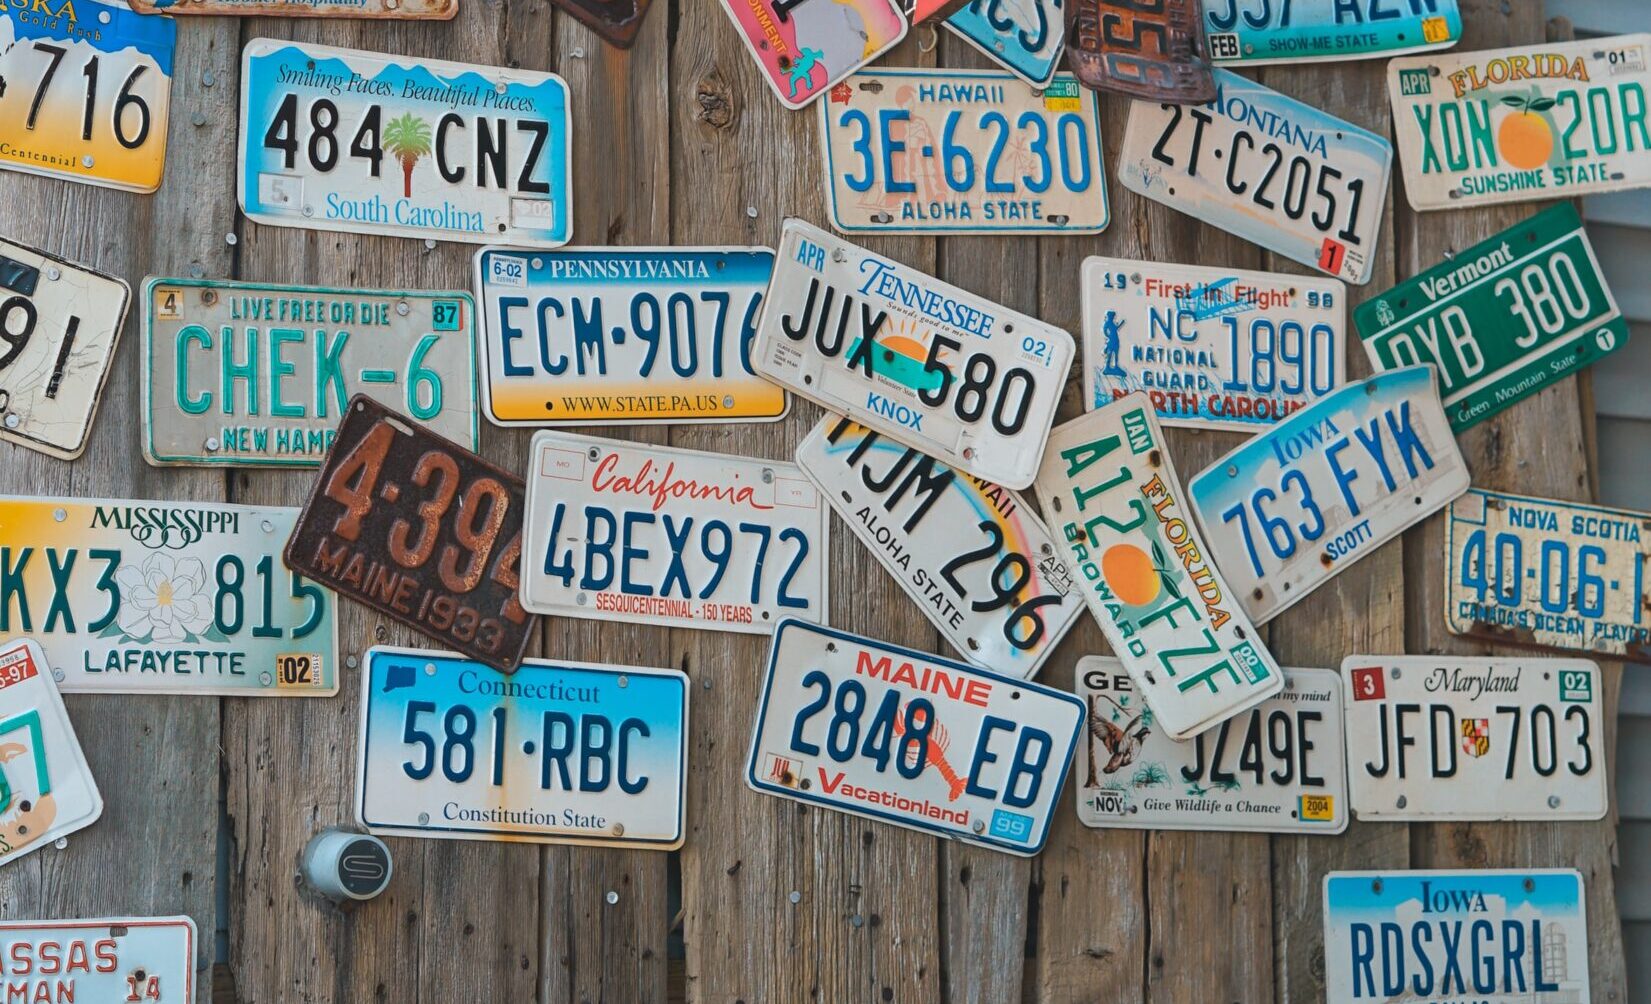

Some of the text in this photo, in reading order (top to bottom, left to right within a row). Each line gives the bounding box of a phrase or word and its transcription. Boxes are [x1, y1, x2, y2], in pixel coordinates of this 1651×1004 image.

[0, 0, 77, 22] SKA
[20, 12, 101, 40] Gold Rush
[1210, 34, 1238, 57] FEB
[1269, 33, 1378, 51] SHOW-ME STATE
[1608, 50, 1626, 64] 01
[276, 63, 343, 95] Smiling
[401, 79, 480, 110] Beautiful
[1065, 82, 1078, 97] 80
[1402, 73, 1430, 95] APR
[1448, 53, 1590, 98] FLORIDA
[919, 83, 1005, 104] HAWAII
[1, 143, 77, 167] Centennial
[264, 93, 550, 194] 484 CNZ
[1461, 163, 1608, 195] SUNSHINE STATE
[326, 191, 485, 233] South Carolina
[902, 201, 1043, 221] ALOHA STATE
[494, 261, 522, 278] 6-02
[550, 259, 710, 279] PENNSYLVANIA
[796, 240, 825, 273] APR
[1327, 245, 1338, 269] 1
[1418, 241, 1514, 301] Vermont
[1104, 272, 1127, 290] 19
[1145, 279, 1290, 311] First in Flight
[164, 293, 177, 313] 4
[231, 297, 390, 325] LIVE FREE OR DIE
[434, 305, 457, 323] 87
[1494, 252, 1590, 348] 380
[887, 301, 918, 319] Sounds
[920, 316, 941, 327] good
[941, 324, 950, 332] to
[1149, 307, 1198, 342] NC
[781, 277, 1035, 436] JUX 580
[1022, 336, 1046, 357] 02
[1132, 345, 1217, 369] NATIONAL
[1221, 315, 1335, 397] 1890
[176, 325, 442, 421] CHEK-6
[1143, 371, 1208, 390] GUARD
[1458, 353, 1576, 424] Green Mountain State
[562, 395, 718, 412] WWW.STATE.PA.US
[867, 392, 923, 431] KNOX
[1112, 388, 1199, 416] RTH
[222, 426, 268, 452] NEW
[1123, 410, 1151, 454] JAN
[592, 453, 774, 511] California
[967, 470, 1017, 519] WAII
[1222, 400, 1435, 578] 763 FYK
[90, 506, 240, 550] MISSISSIPPI
[1325, 519, 1373, 561] SCOTT
[1509, 507, 1641, 543] NOVA SCOTIA
[544, 503, 809, 609] 4BEX972
[856, 506, 964, 630] ALOHA STATE
[1061, 434, 1243, 695] A12 FZF
[1140, 473, 1231, 632] FLORIDA
[214, 554, 325, 639] 815
[312, 536, 504, 651] MAINE 1933
[940, 520, 1063, 650] 296
[1063, 521, 1146, 658] BROWARD
[596, 592, 753, 624] SESQUICENTENNIAL 150 YEARS
[1535, 613, 1585, 636] OCEAN
[85, 649, 246, 675] LAFAYETTE
[284, 656, 311, 684] 02
[1240, 646, 1258, 667] 00
[458, 670, 600, 703] Connecticut
[855, 650, 993, 708] MAINE
[1363, 673, 1375, 695] 3
[1424, 666, 1522, 701] Maryland
[1564, 672, 1588, 690] 02
[1284, 691, 1299, 704] my
[1301, 690, 1331, 702] mind
[790, 670, 1053, 808] 2848 EB
[1365, 703, 1592, 780] JFD 703
[817, 767, 969, 826] Vacationland
[1096, 796, 1123, 812] NOV
[1143, 799, 1281, 814] Give Wildlife a Chance
[1307, 800, 1329, 811] 2004
[442, 801, 606, 829] Constitution State
[996, 817, 1026, 836] 99
[0, 940, 118, 975] SSAS
[1350, 919, 1559, 998] RDSXGRL
[0, 980, 75, 1004] MAN
[127, 975, 160, 1001] 14
